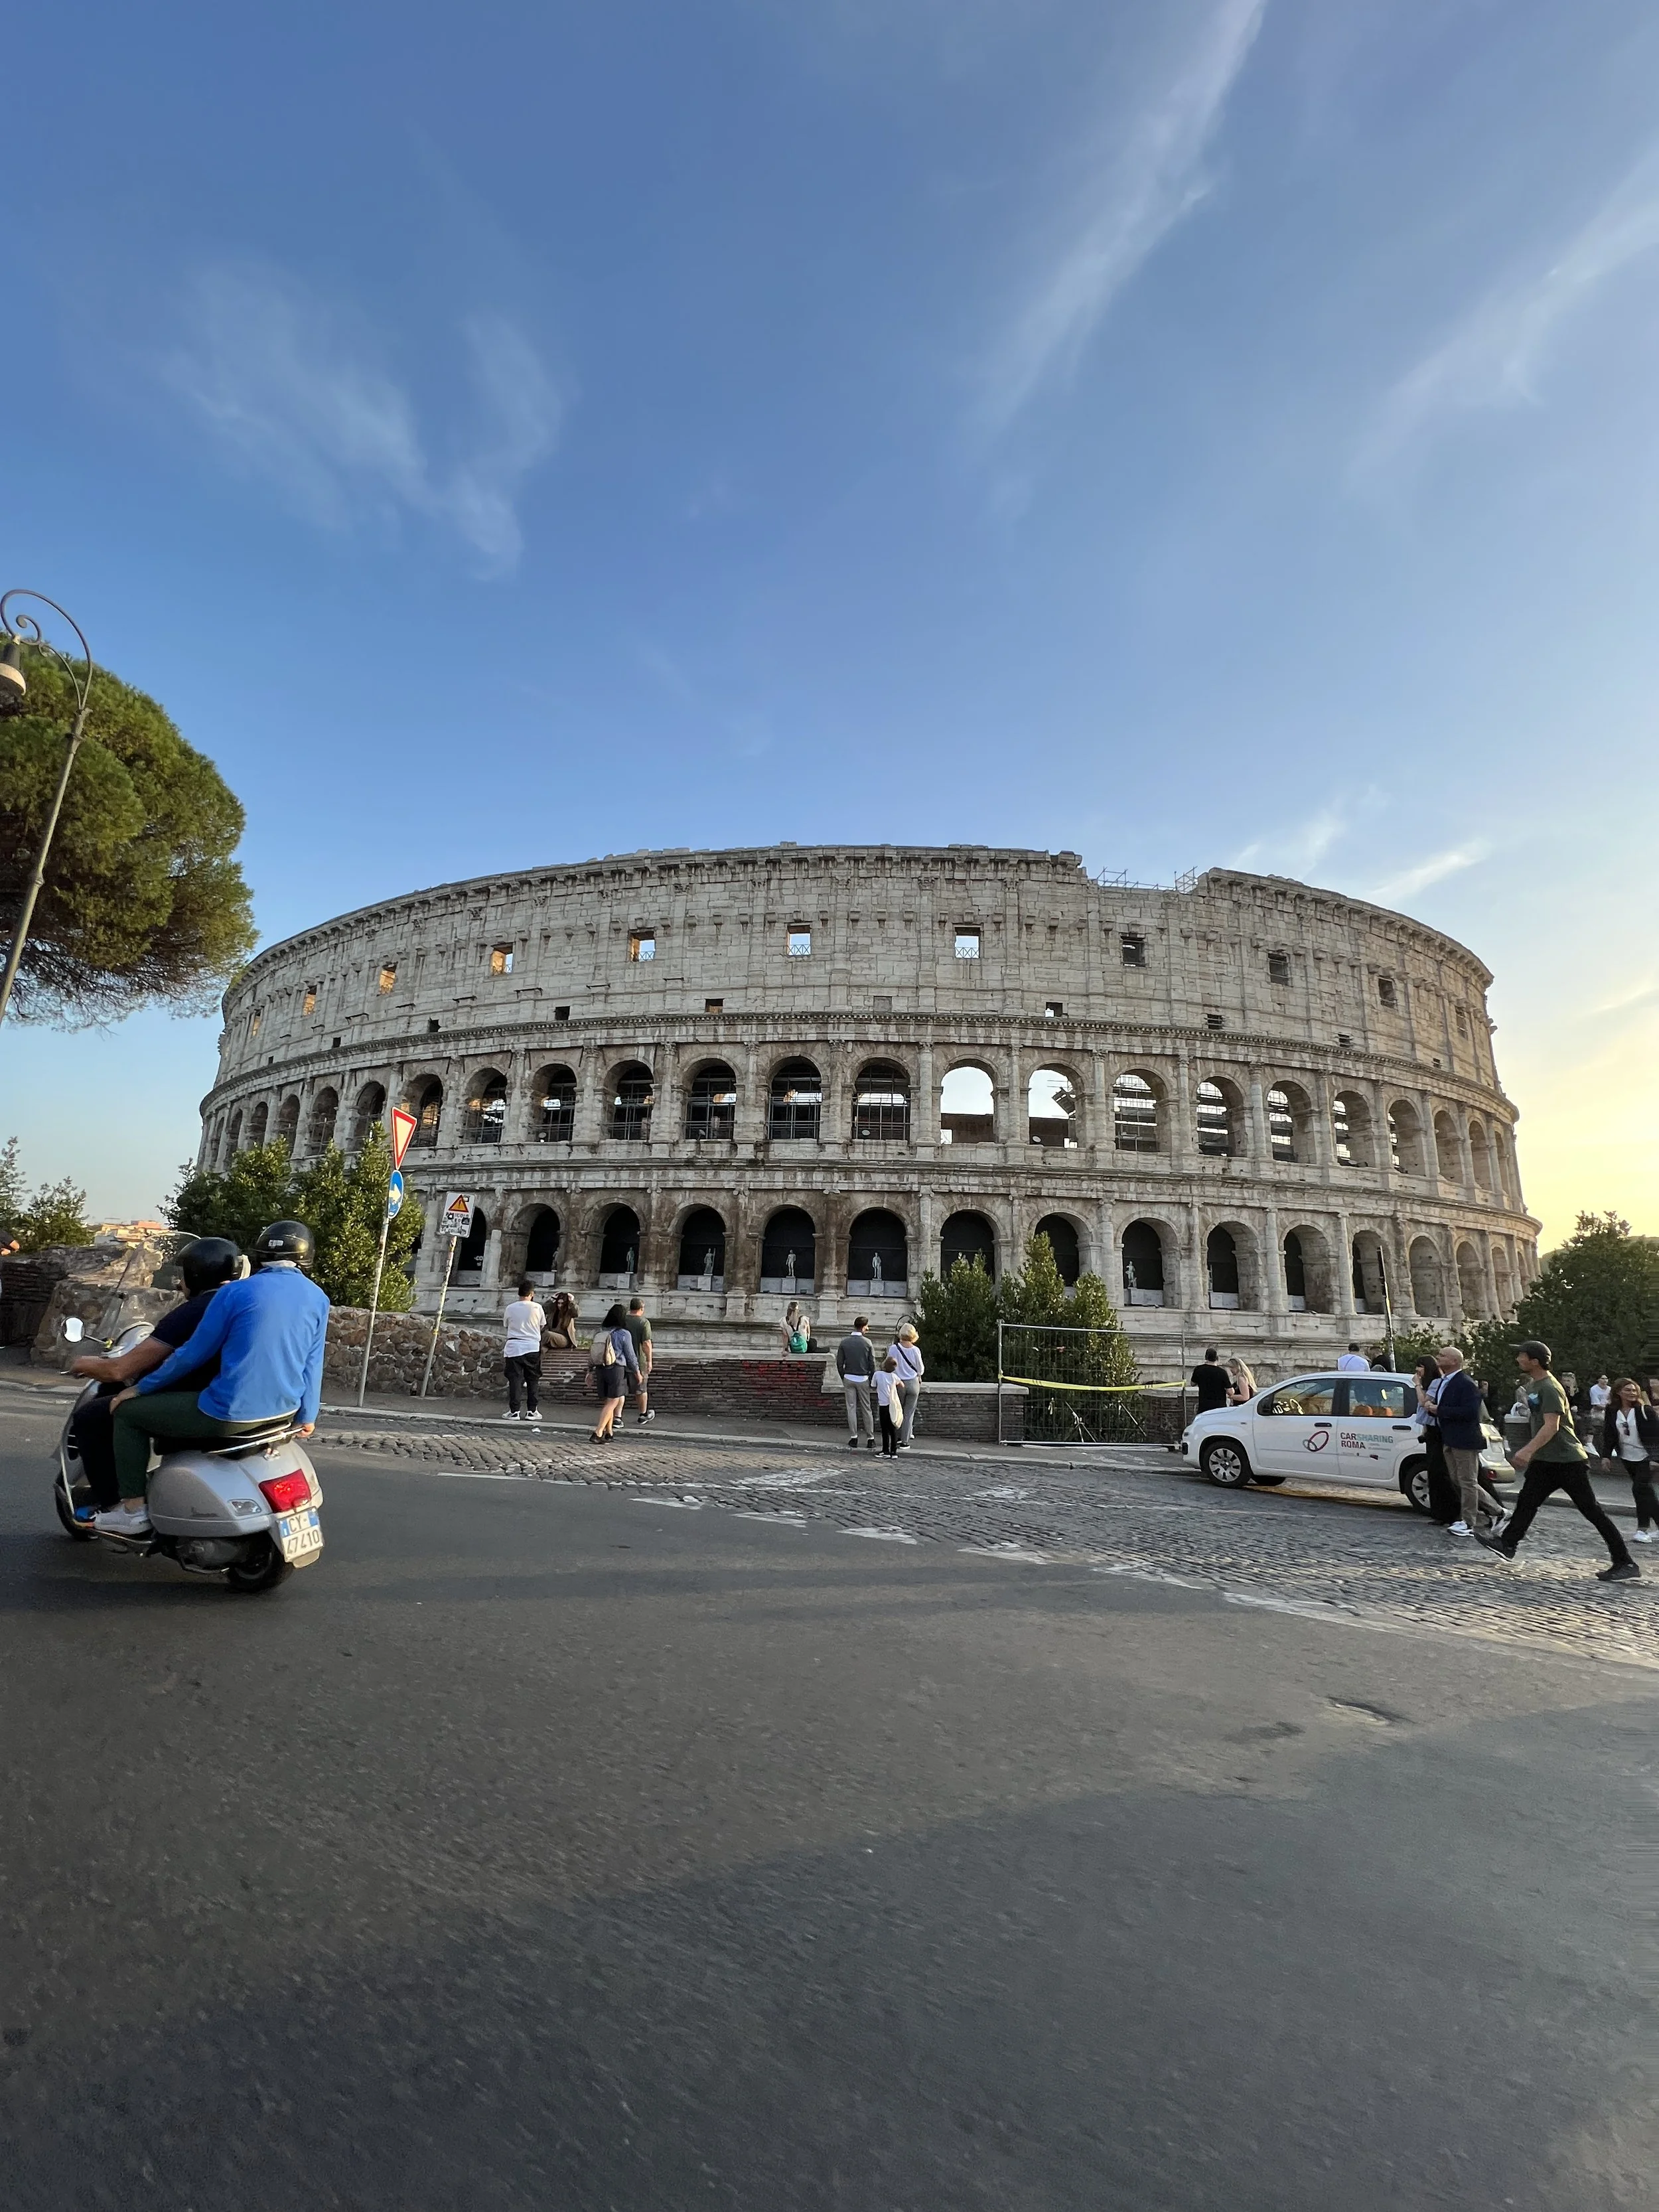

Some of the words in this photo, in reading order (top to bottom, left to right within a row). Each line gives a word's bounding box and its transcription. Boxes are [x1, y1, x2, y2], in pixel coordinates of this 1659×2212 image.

[1340, 1432, 1394, 1443] CARSHARING
[1341, 1440, 1366, 1449] ROMA
[289, 1514, 301, 1532] CY
[287, 1529, 320, 1554] 47410
